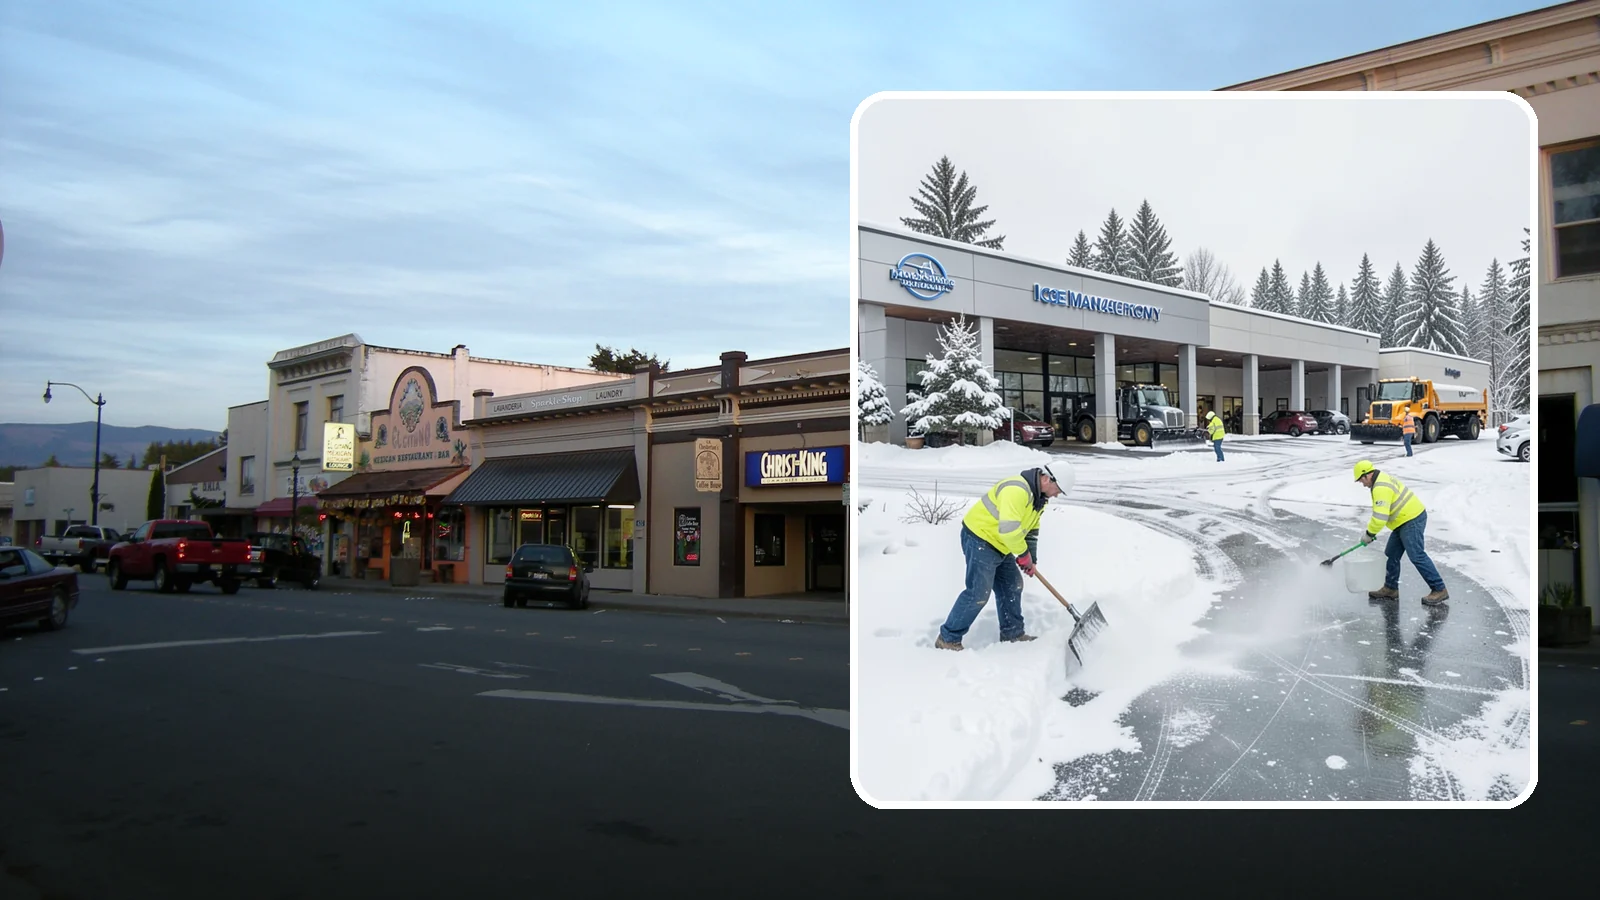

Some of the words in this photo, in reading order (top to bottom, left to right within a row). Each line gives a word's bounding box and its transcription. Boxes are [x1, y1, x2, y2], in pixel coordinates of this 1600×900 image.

[530, 398, 561, 409] Sparkle
[562, 394, 582, 405] Shop
[595, 389, 623, 400] LAUNDRY
[493, 402, 523, 412] LAVANDERIA
[374, 454, 396, 464] MEXICAN
[397, 451, 433, 462] RESTAURANT
[438, 450, 450, 459] BAR
[761, 452, 797, 478] CHRIST
[799, 450, 827, 476] KING
